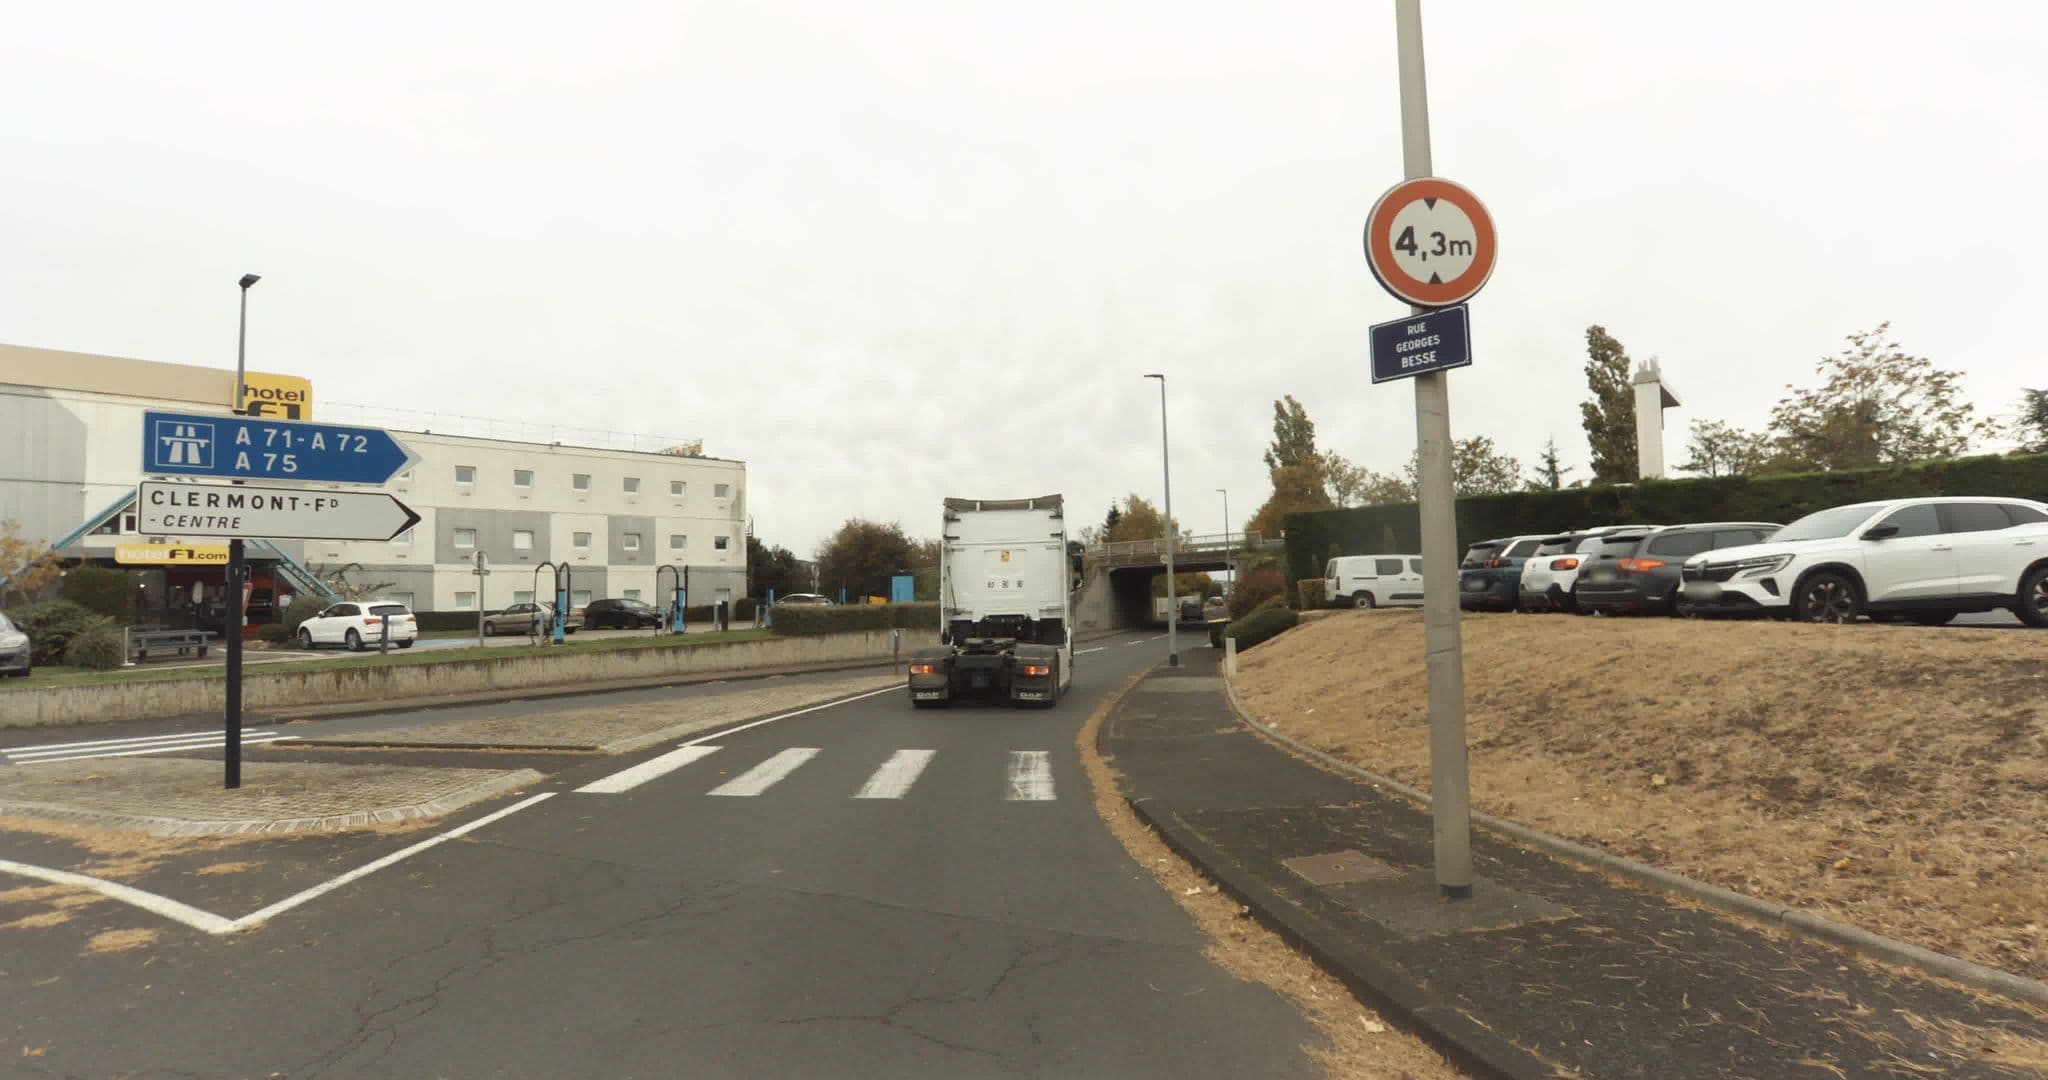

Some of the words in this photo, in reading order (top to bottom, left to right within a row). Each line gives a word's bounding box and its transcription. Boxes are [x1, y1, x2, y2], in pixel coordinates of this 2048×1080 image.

[1395, 226, 1472, 261] 4,3m
[1407, 321, 1427, 335] RUE
[1396, 334, 1440, 353] GEORGES
[1401, 350, 1436, 368] BESSE
[243, 384, 304, 402] hotel
[235, 426, 251, 446] A
[336, 433, 368, 453] 72
[234, 451, 251, 471] A
[263, 453, 298, 473] 75
